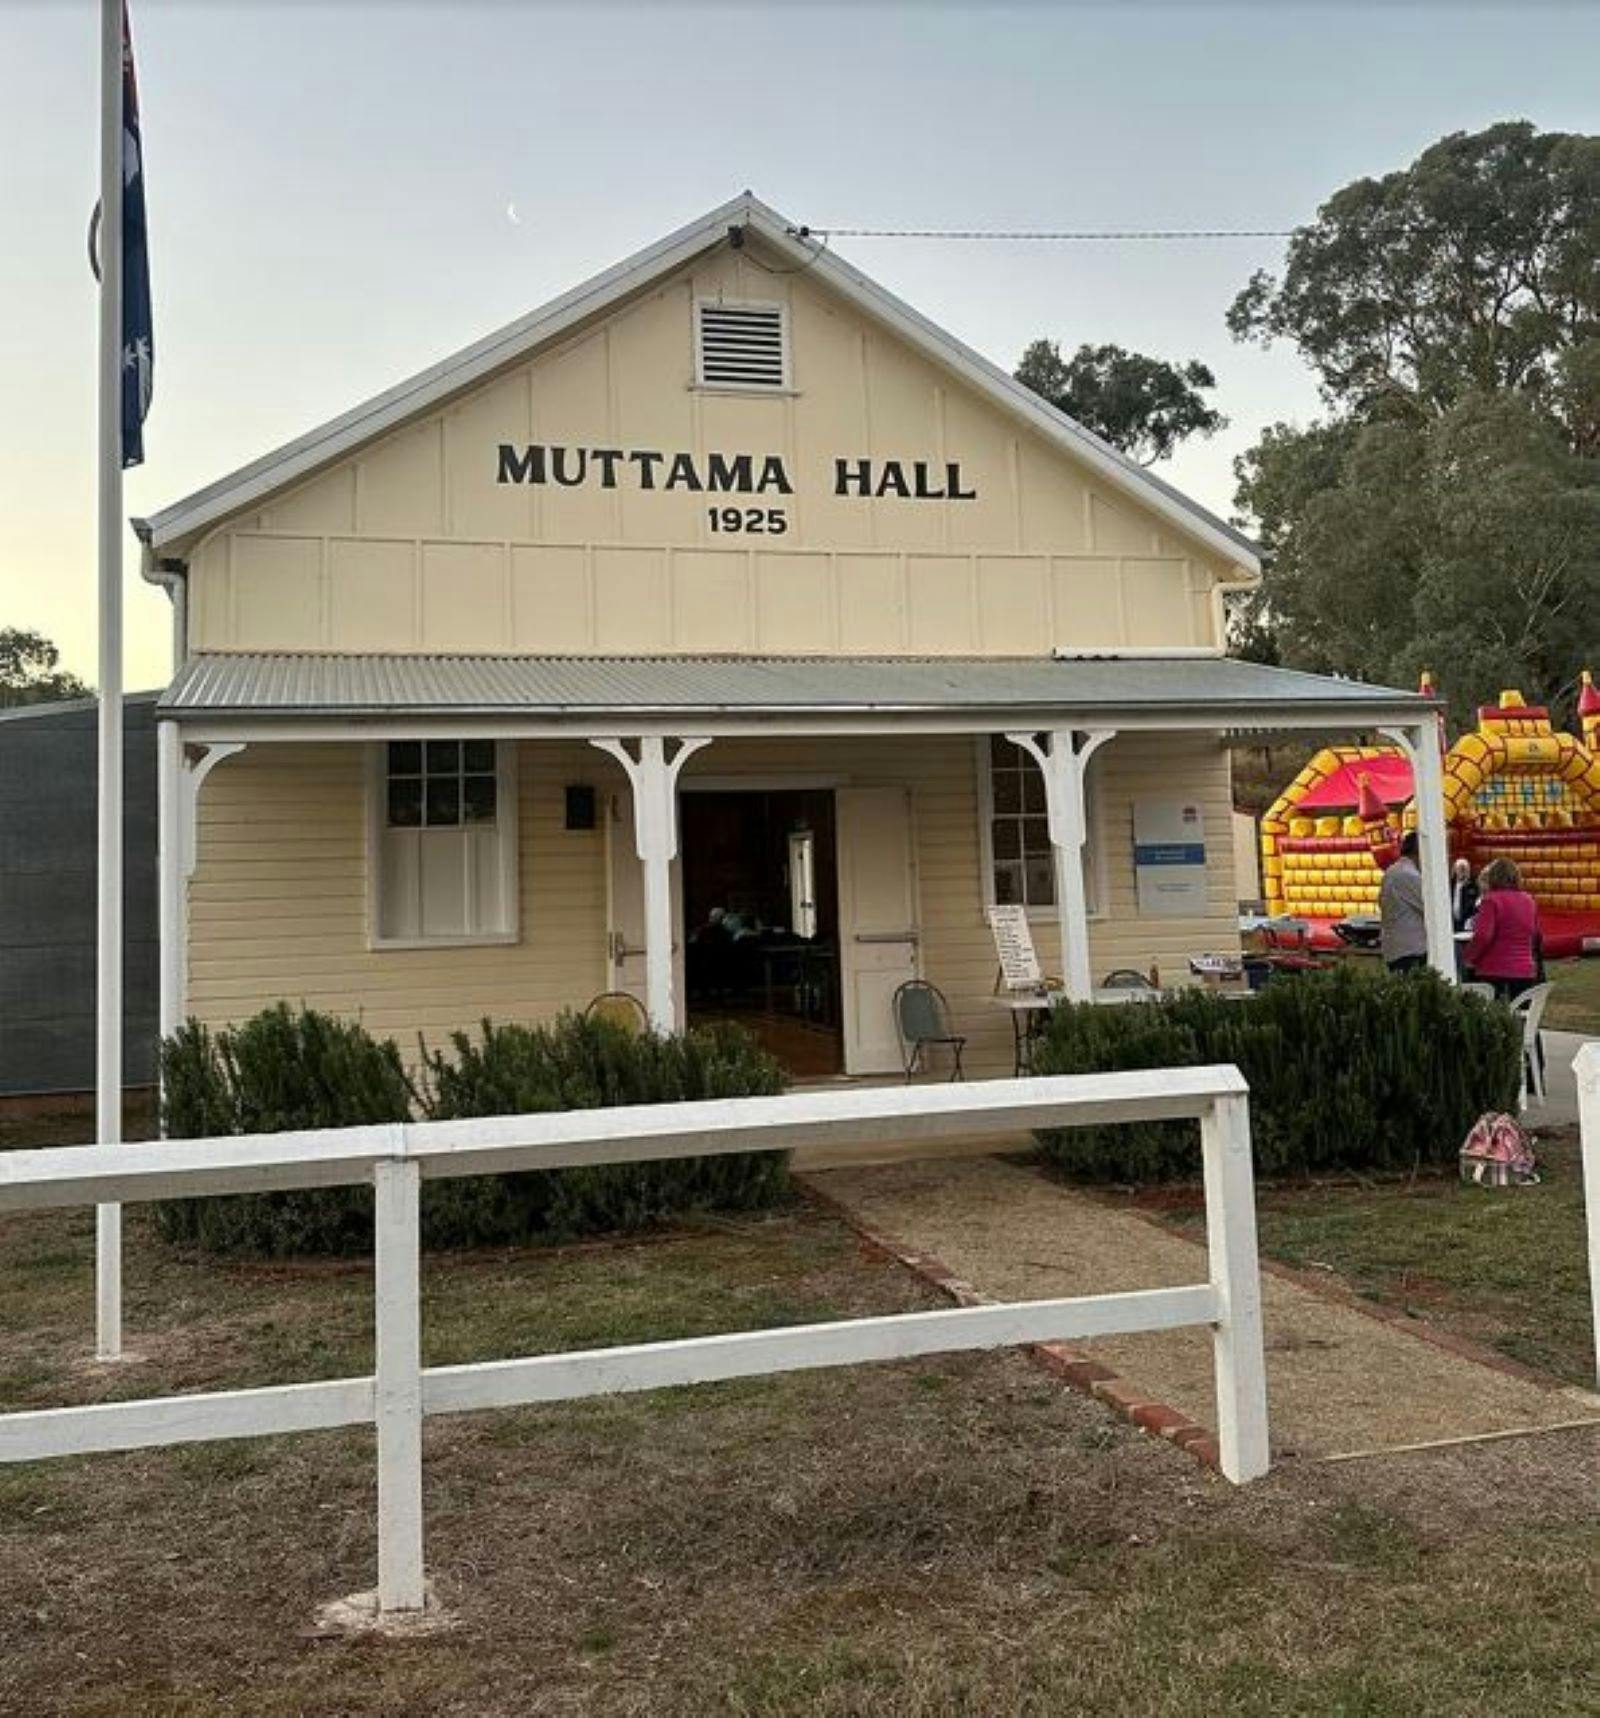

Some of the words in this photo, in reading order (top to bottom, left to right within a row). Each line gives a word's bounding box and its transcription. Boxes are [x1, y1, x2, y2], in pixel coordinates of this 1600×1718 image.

[497, 444, 794, 495] MUTTAMA
[835, 458, 977, 500] HALL
[708, 507, 788, 535] 1925
